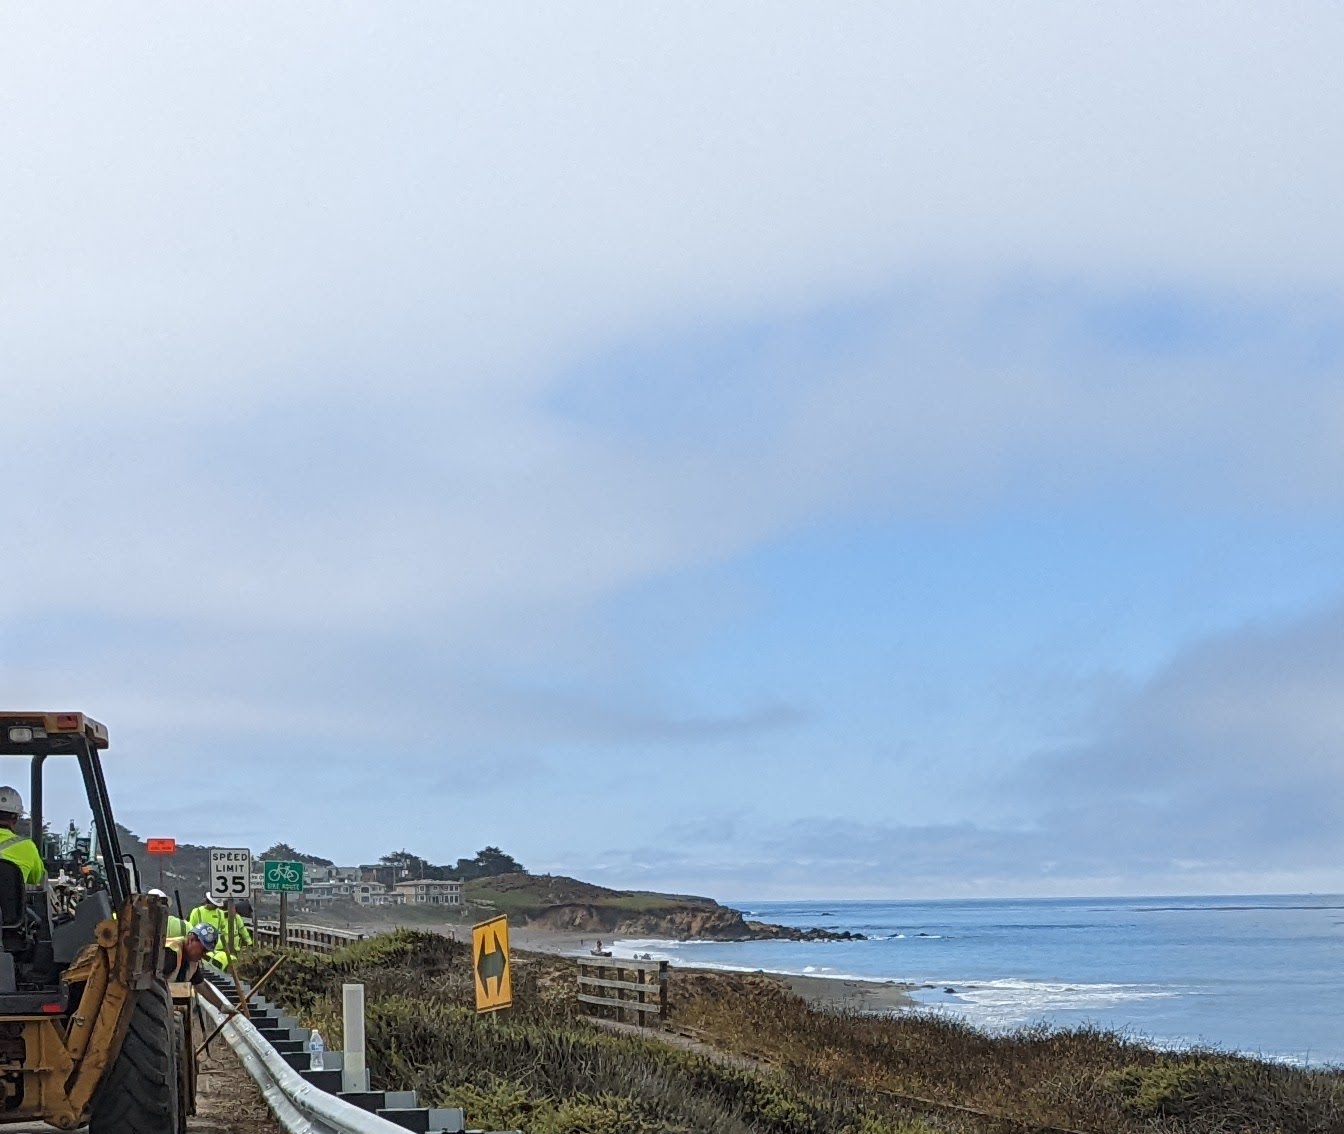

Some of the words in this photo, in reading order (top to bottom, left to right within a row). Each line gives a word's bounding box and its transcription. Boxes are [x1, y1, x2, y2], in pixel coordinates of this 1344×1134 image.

[212, 853, 248, 861] SPEED
[216, 864, 245, 872] LIMIT
[215, 876, 246, 893] 35
